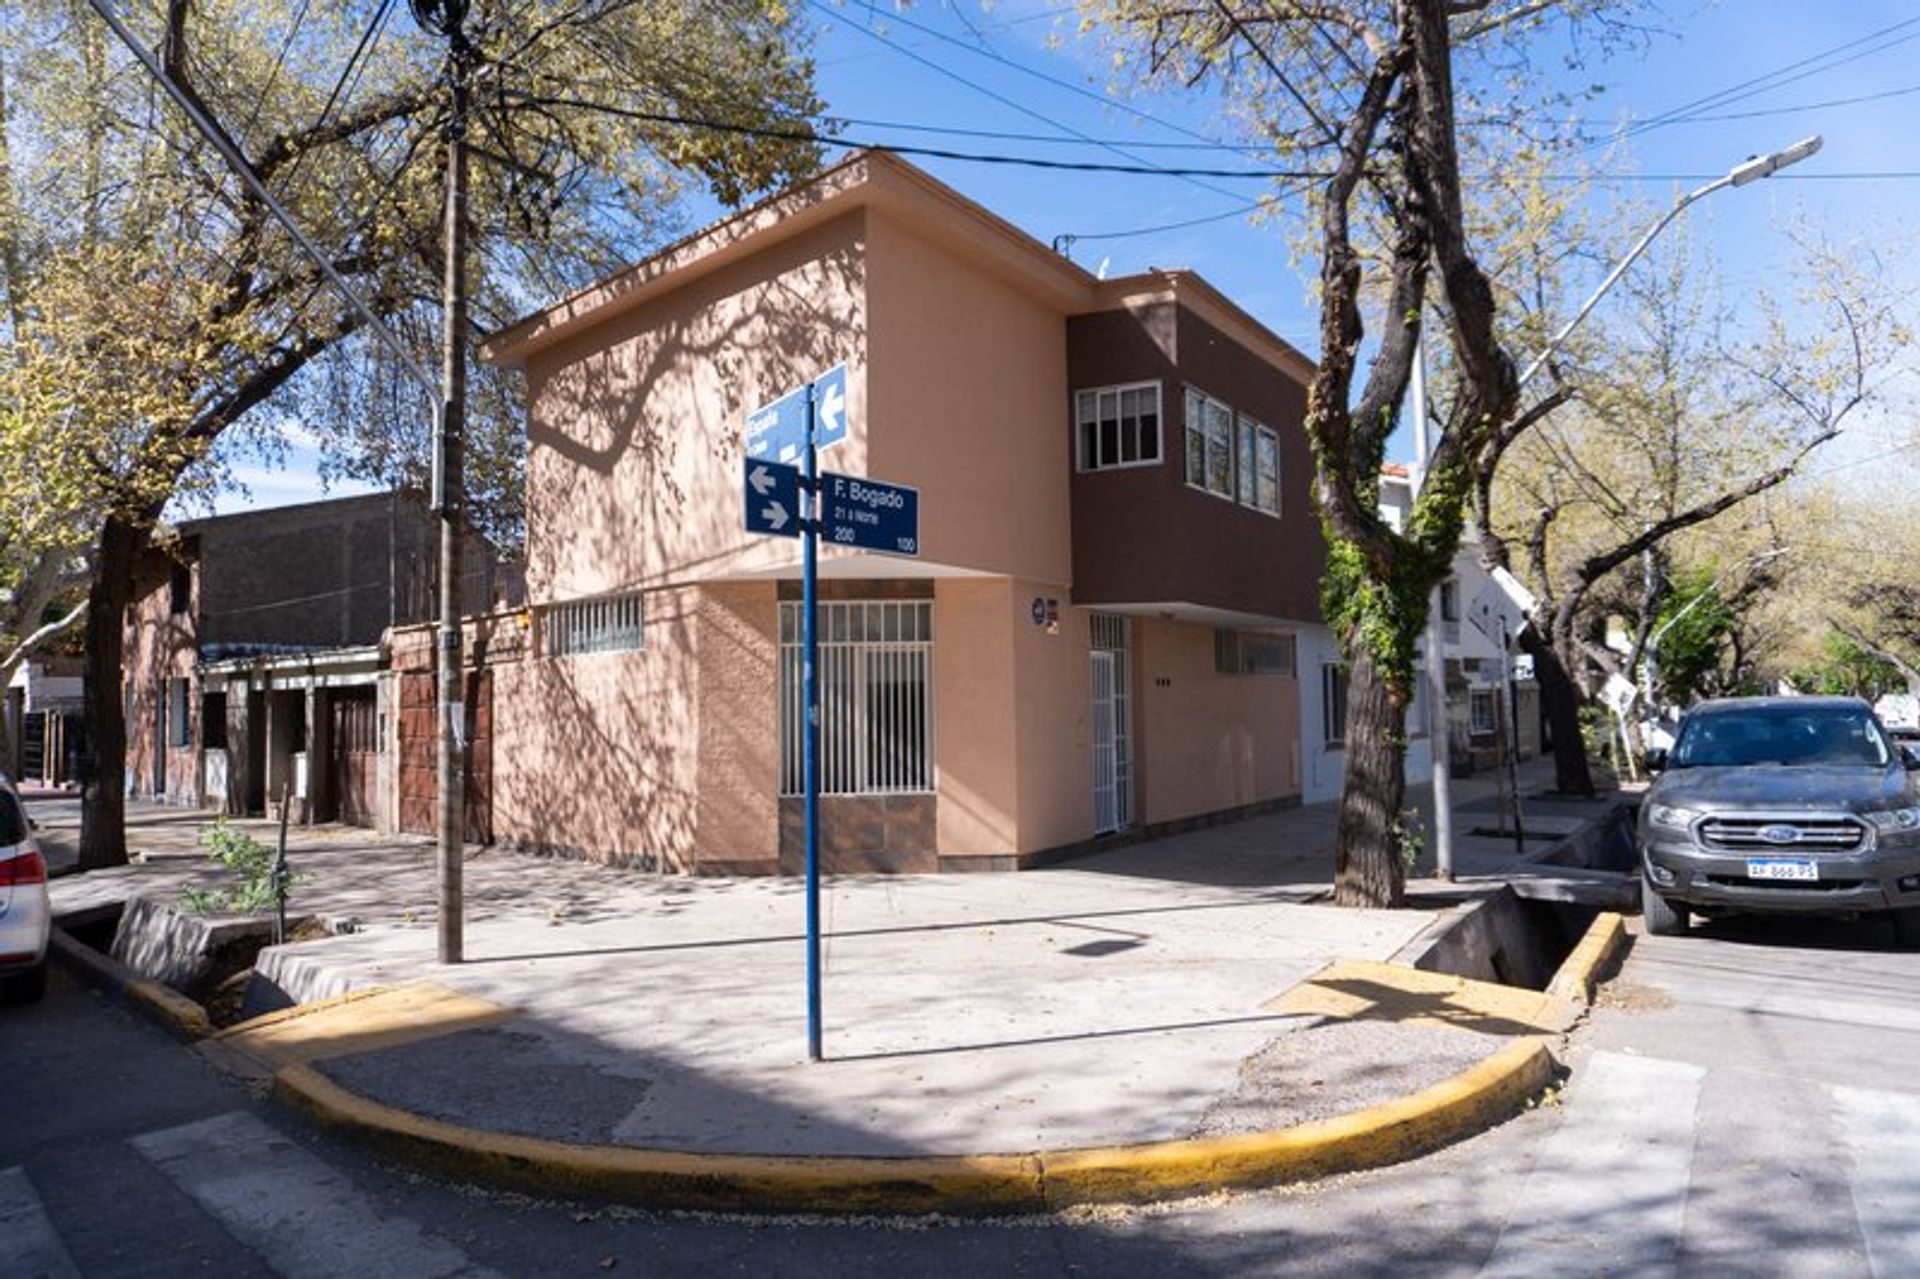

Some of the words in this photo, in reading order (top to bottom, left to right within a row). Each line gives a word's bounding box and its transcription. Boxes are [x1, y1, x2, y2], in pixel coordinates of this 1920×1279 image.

[835, 479, 847, 498] F.
[850, 482, 904, 509] Bogado
[834, 526, 855, 542] 200
[897, 537, 916, 551] 100
